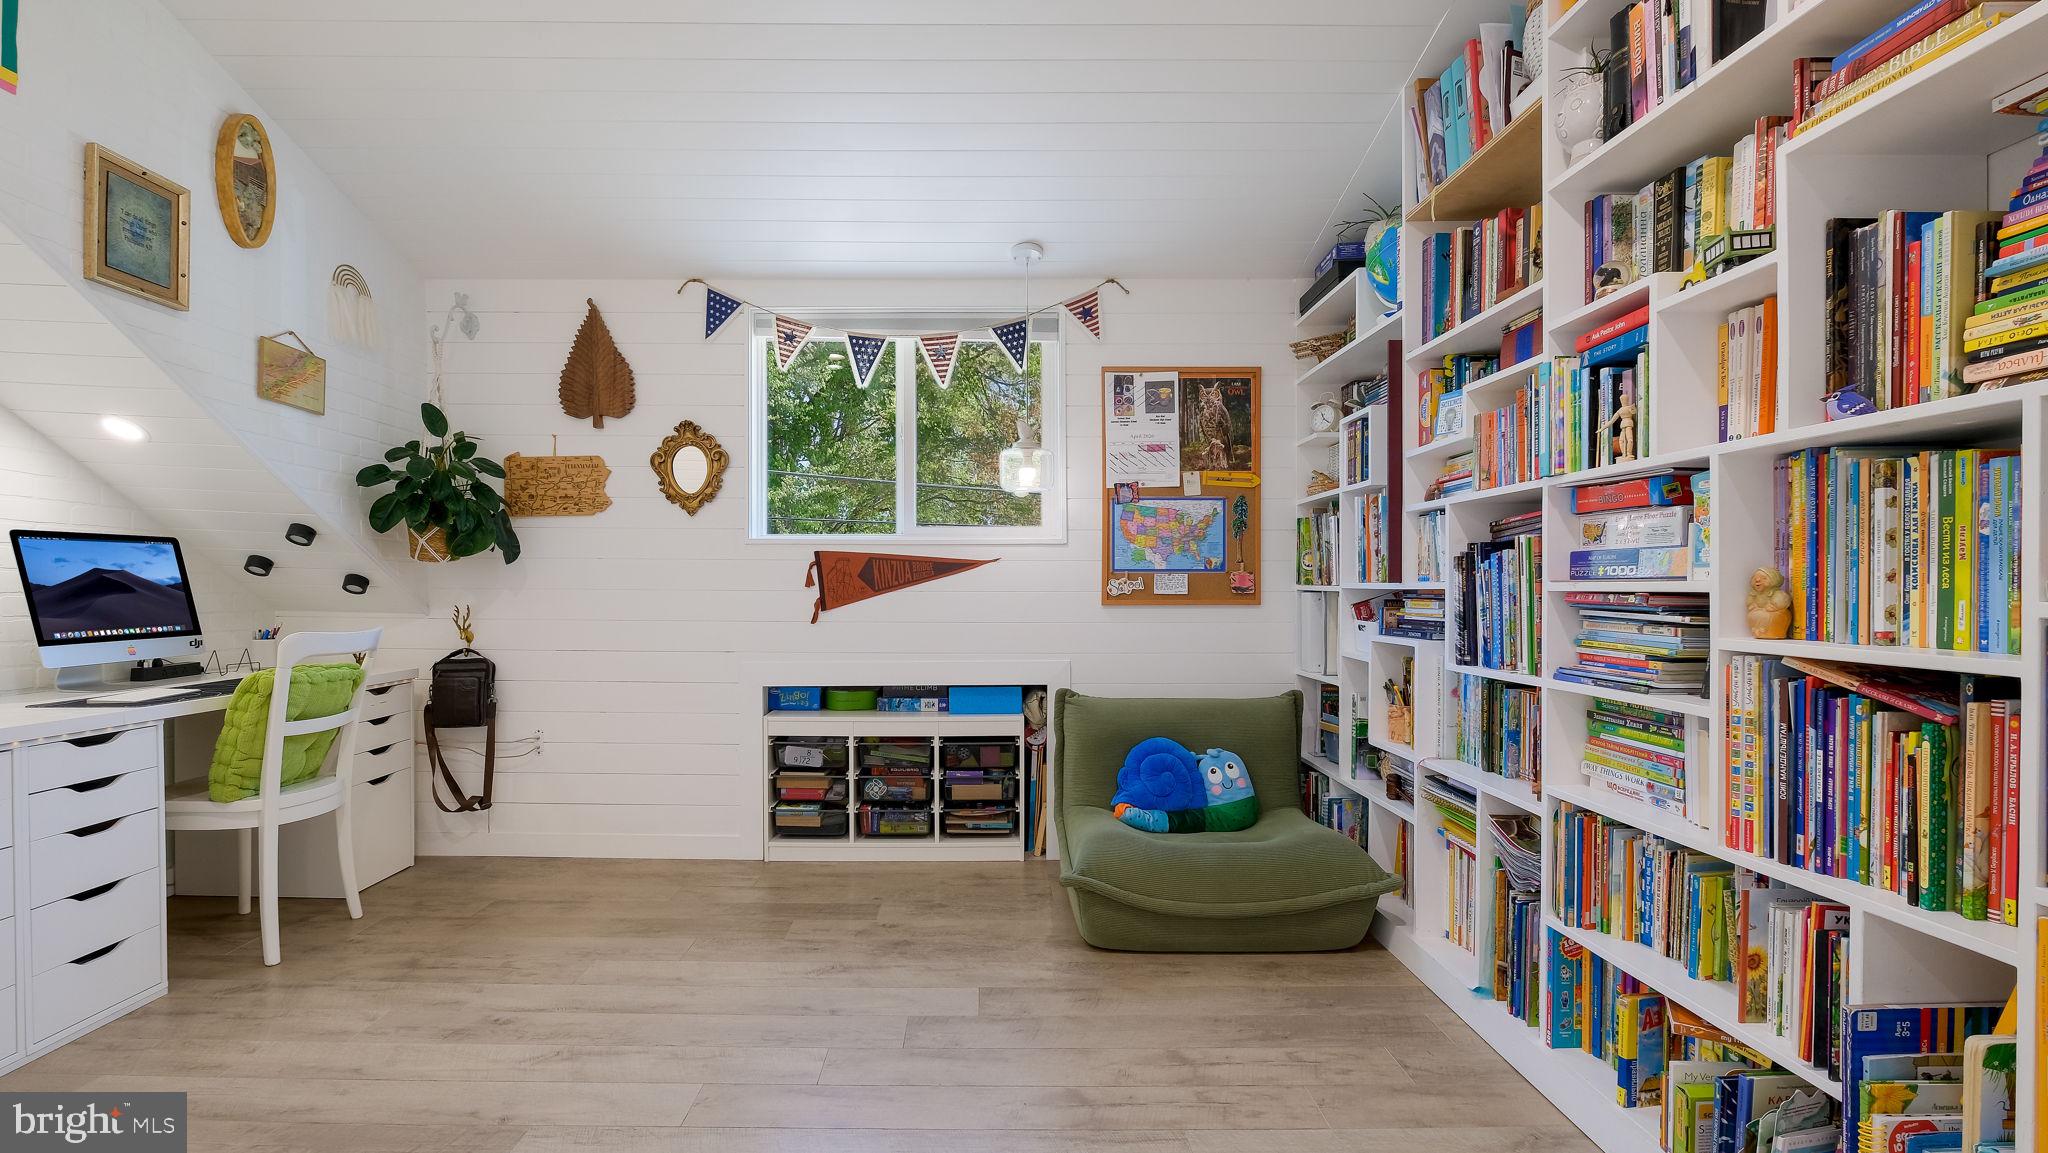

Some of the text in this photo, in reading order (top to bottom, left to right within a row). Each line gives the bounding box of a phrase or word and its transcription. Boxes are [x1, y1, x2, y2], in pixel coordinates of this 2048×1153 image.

[1887, 24, 1950, 73] BIBLE
[1799, 125, 1809, 133] MY
[1811, 111, 1834, 128] FIRST
[1835, 95, 1858, 115] BIBLE
[1861, 65, 1914, 98] DICTIONARY
[1591, 321, 1626, 341] Ask Pastor John
[1602, 343, 1617, 354] STORY
[1598, 493, 1625, 504] BINGO
[1911, 482, 1919, 590] КОЛИСКОВА ДЛЯ ЇЖАЧКА
[1940, 516, 1954, 551] Вести
[873, 558, 912, 591] KINZUA
[1940, 566, 1951, 590] леса
[1780, 722, 1788, 800] ОСИП МАНДЕЛЬШТАМ
[2009, 754, 2018, 789] КРЫЛОВ
[1599, 767, 1623, 780] THINGS
[1624, 774, 1646, 786] WORK
[2008, 797, 2017, 826] БАСНИ
[1893, 1021, 1902, 1038] Ages
[1901, 1020, 1911, 1037] 3-5
[1684, 1072, 1713, 1082] My Ver
